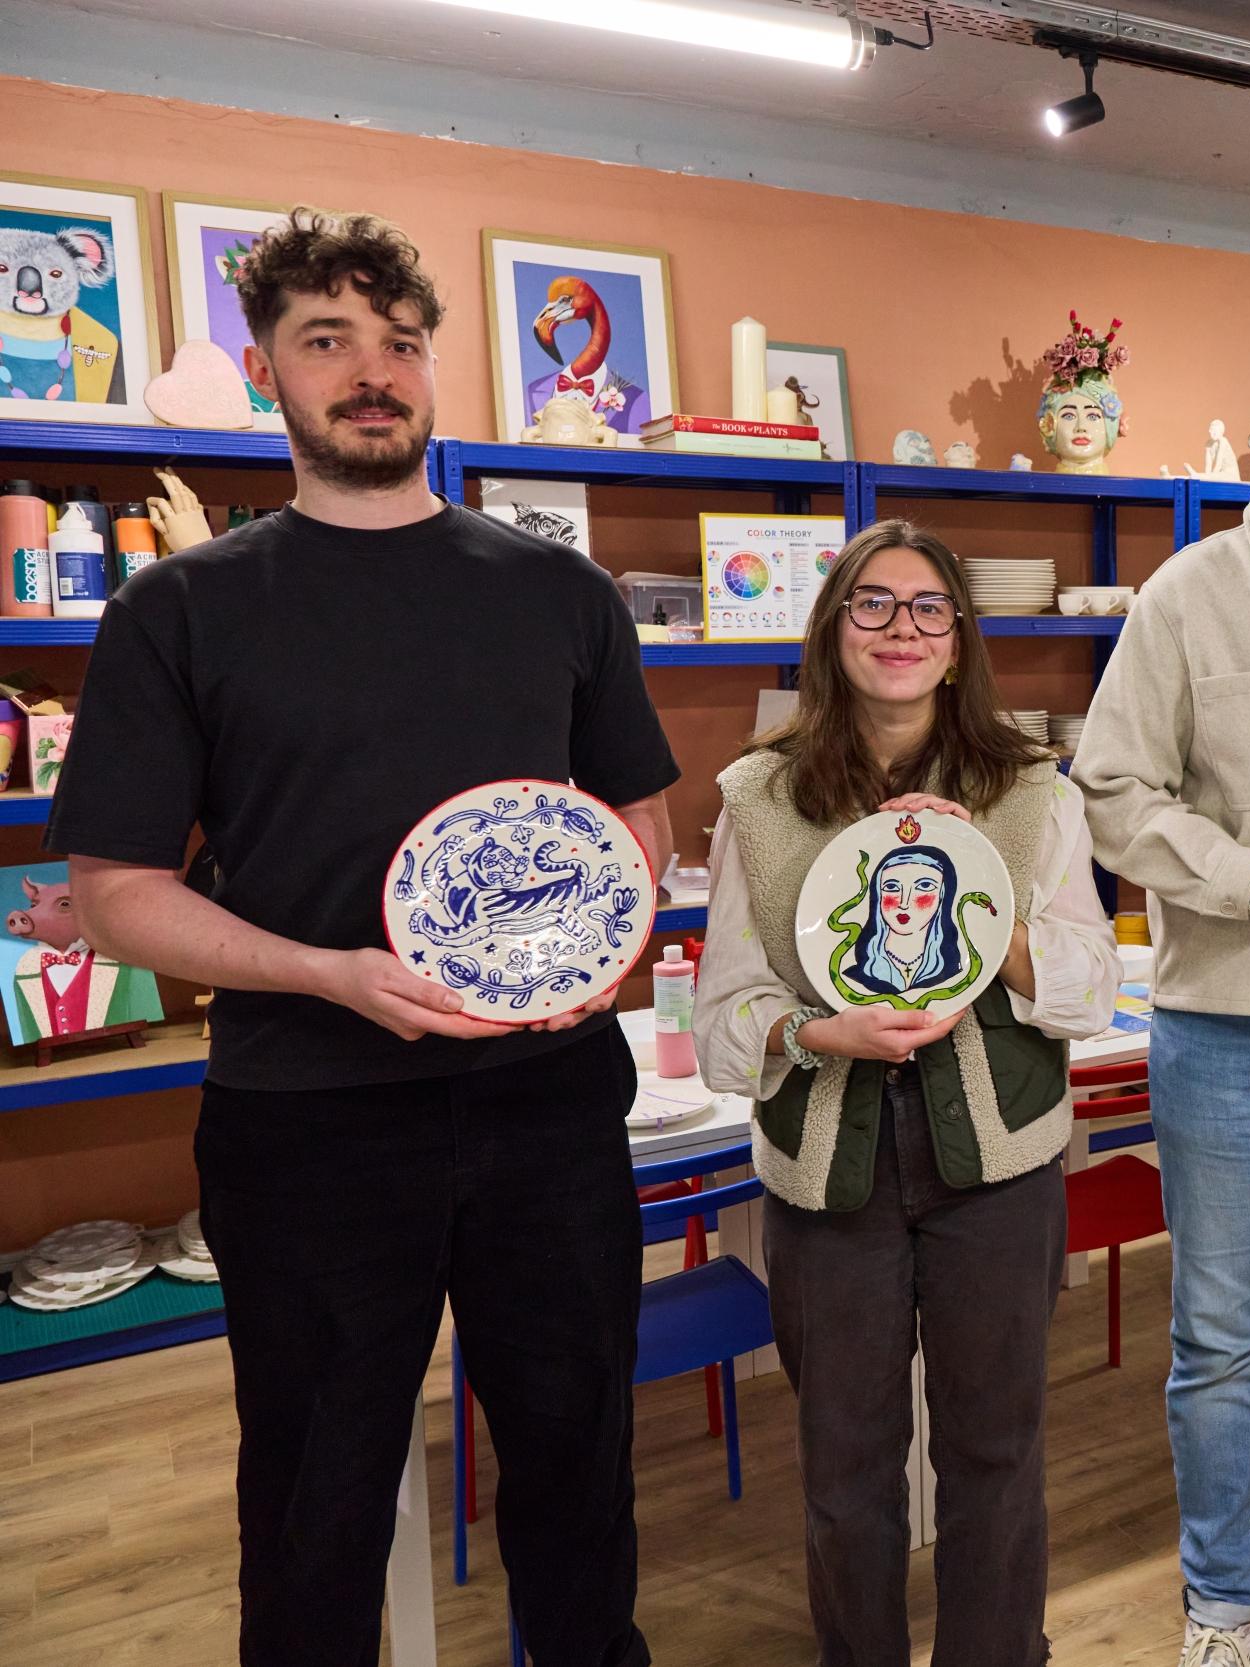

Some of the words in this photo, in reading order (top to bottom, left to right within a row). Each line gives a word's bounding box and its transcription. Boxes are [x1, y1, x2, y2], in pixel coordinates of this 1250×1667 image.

[721, 423, 747, 433] BOOK
[754, 426, 788, 436] PLANTS
[747, 529, 777, 537] COLOR
[780, 529, 812, 538] THEORY
